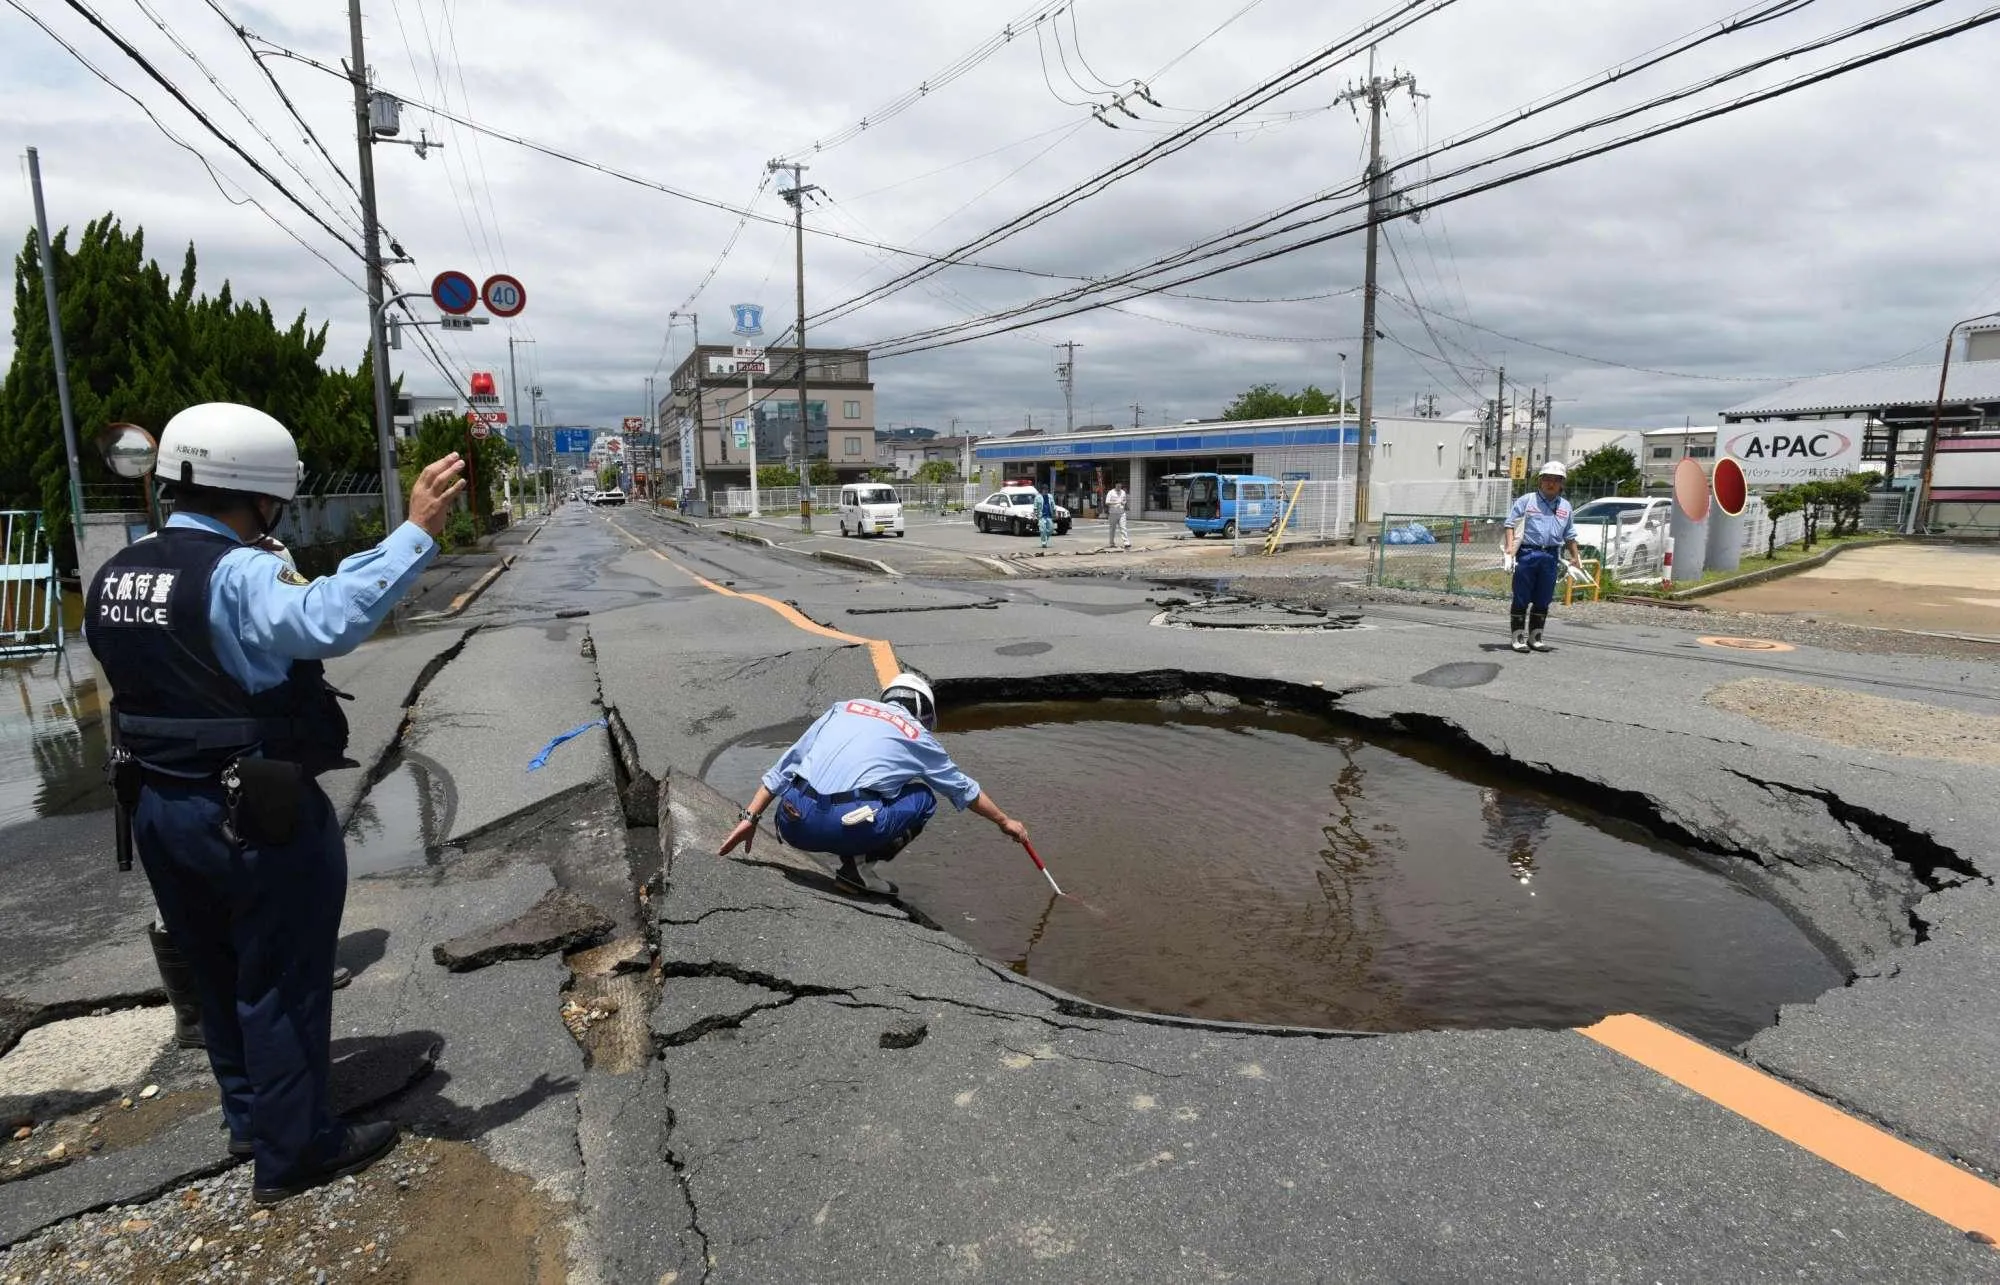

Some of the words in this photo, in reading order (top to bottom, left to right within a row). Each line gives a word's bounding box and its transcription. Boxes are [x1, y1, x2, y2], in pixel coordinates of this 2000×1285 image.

[493, 286, 516, 305] 40
[442, 318, 471, 328] 自動車
[176, 443, 208, 457] 大阪府警
[1744, 467, 1849, 478] パッケージング株式会社
[987, 512, 1007, 522] POLICE
[101, 572, 174, 603] 大阪府警
[101, 605, 168, 625] POLICE
